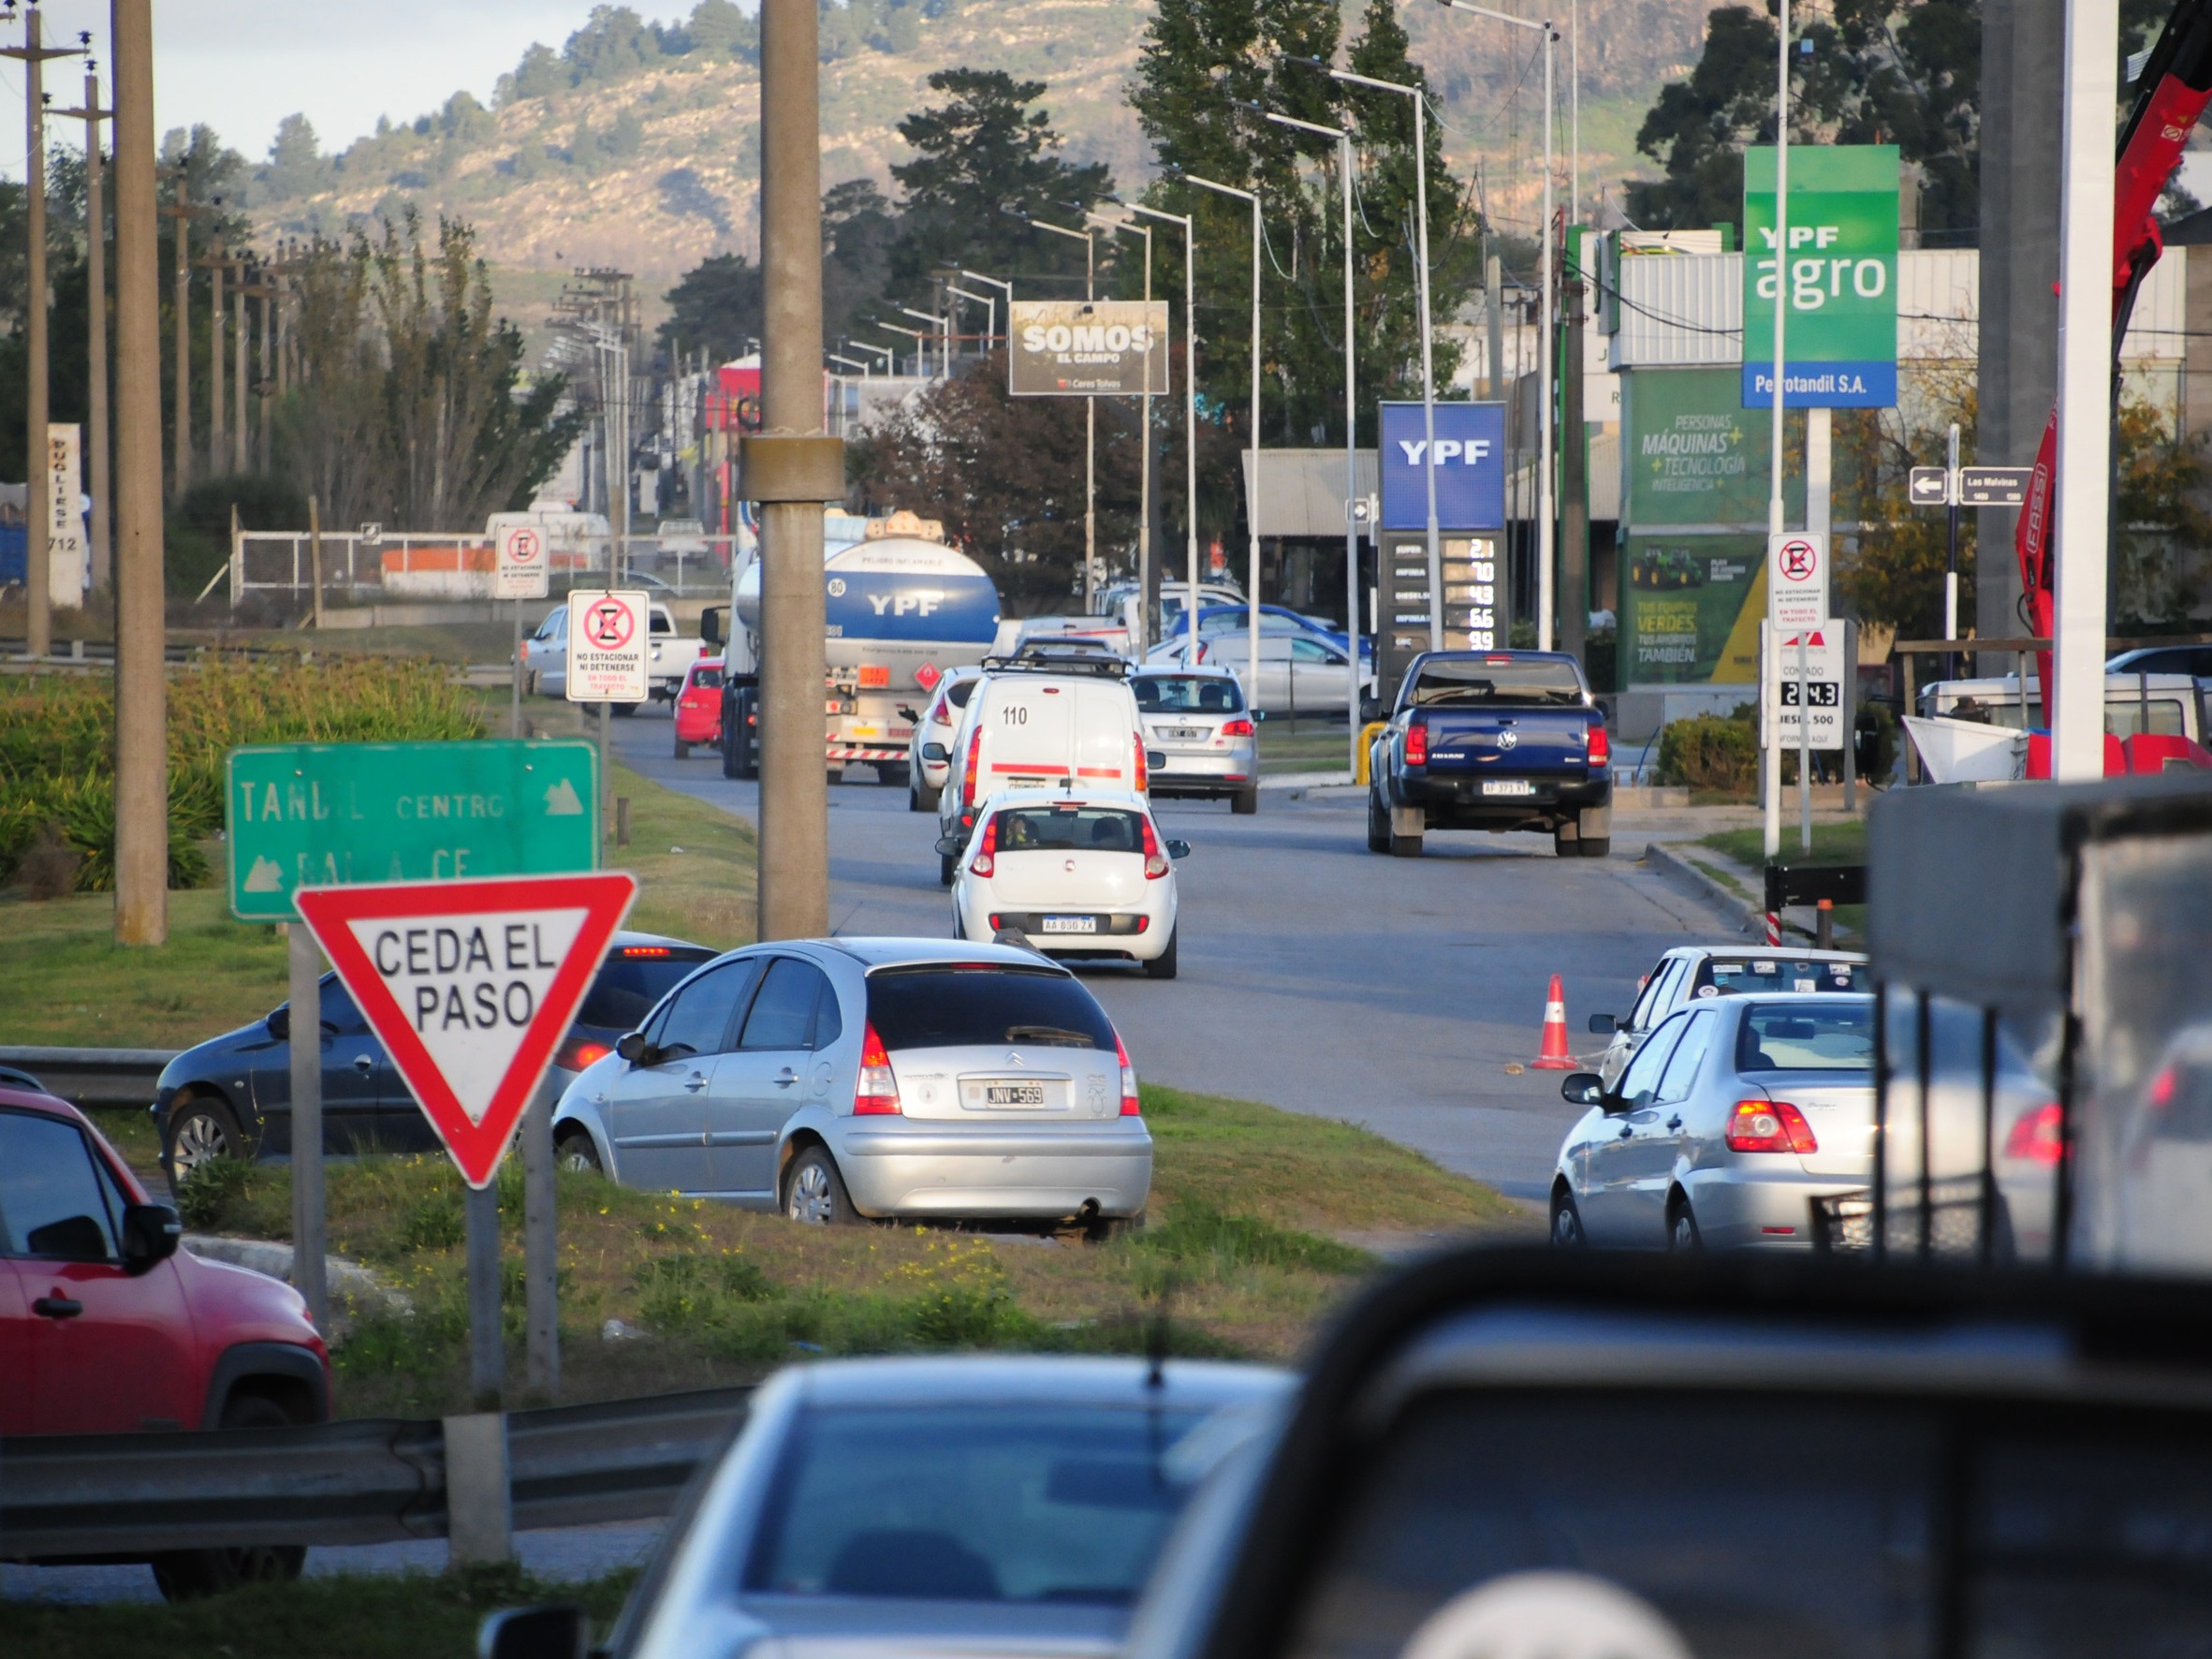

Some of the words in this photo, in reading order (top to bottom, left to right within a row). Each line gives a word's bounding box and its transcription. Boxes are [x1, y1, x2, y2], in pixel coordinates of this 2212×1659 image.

[1759, 227, 1839, 249] YPF
[1756, 258, 1886, 310] agro
[1023, 324, 1154, 353] SOMOS
[1057, 353, 1072, 363] EL
[1074, 353, 1121, 364] CAMPO
[1073, 379, 1095, 389] Ceres
[1755, 374, 1835, 393] Peotandil
[1838, 374, 1867, 393] S.A.
[1675, 415, 1732, 431] PERSONAS
[1642, 426, 1728, 455] MÁQUINAS
[1399, 440, 1491, 466] YPF
[1663, 453, 1746, 476] TECNOLOGÍA
[53, 439, 66, 529] PUGLIESE
[1984, 477, 2018, 487] Malvinas
[2028, 470, 2046, 547] FASSI
[48, 538, 77, 551] 712
[830, 581, 843, 595] 80
[868, 591, 945, 617] YPF
[577, 653, 588, 661] NO
[591, 653, 638, 661] ESTACIONAR
[579, 663, 588, 671] NI
[590, 663, 636, 672] DETENERSE
[1003, 706, 1028, 726] 110
[1813, 715, 1834, 725] 500
[1046, 921, 1057, 930] AA
[375, 926, 493, 977] CEDA
[506, 923, 556, 970] EL
[416, 980, 534, 1033] PASO
[988, 1088, 1012, 1105] JNV
[1018, 1088, 1043, 1104] 569
